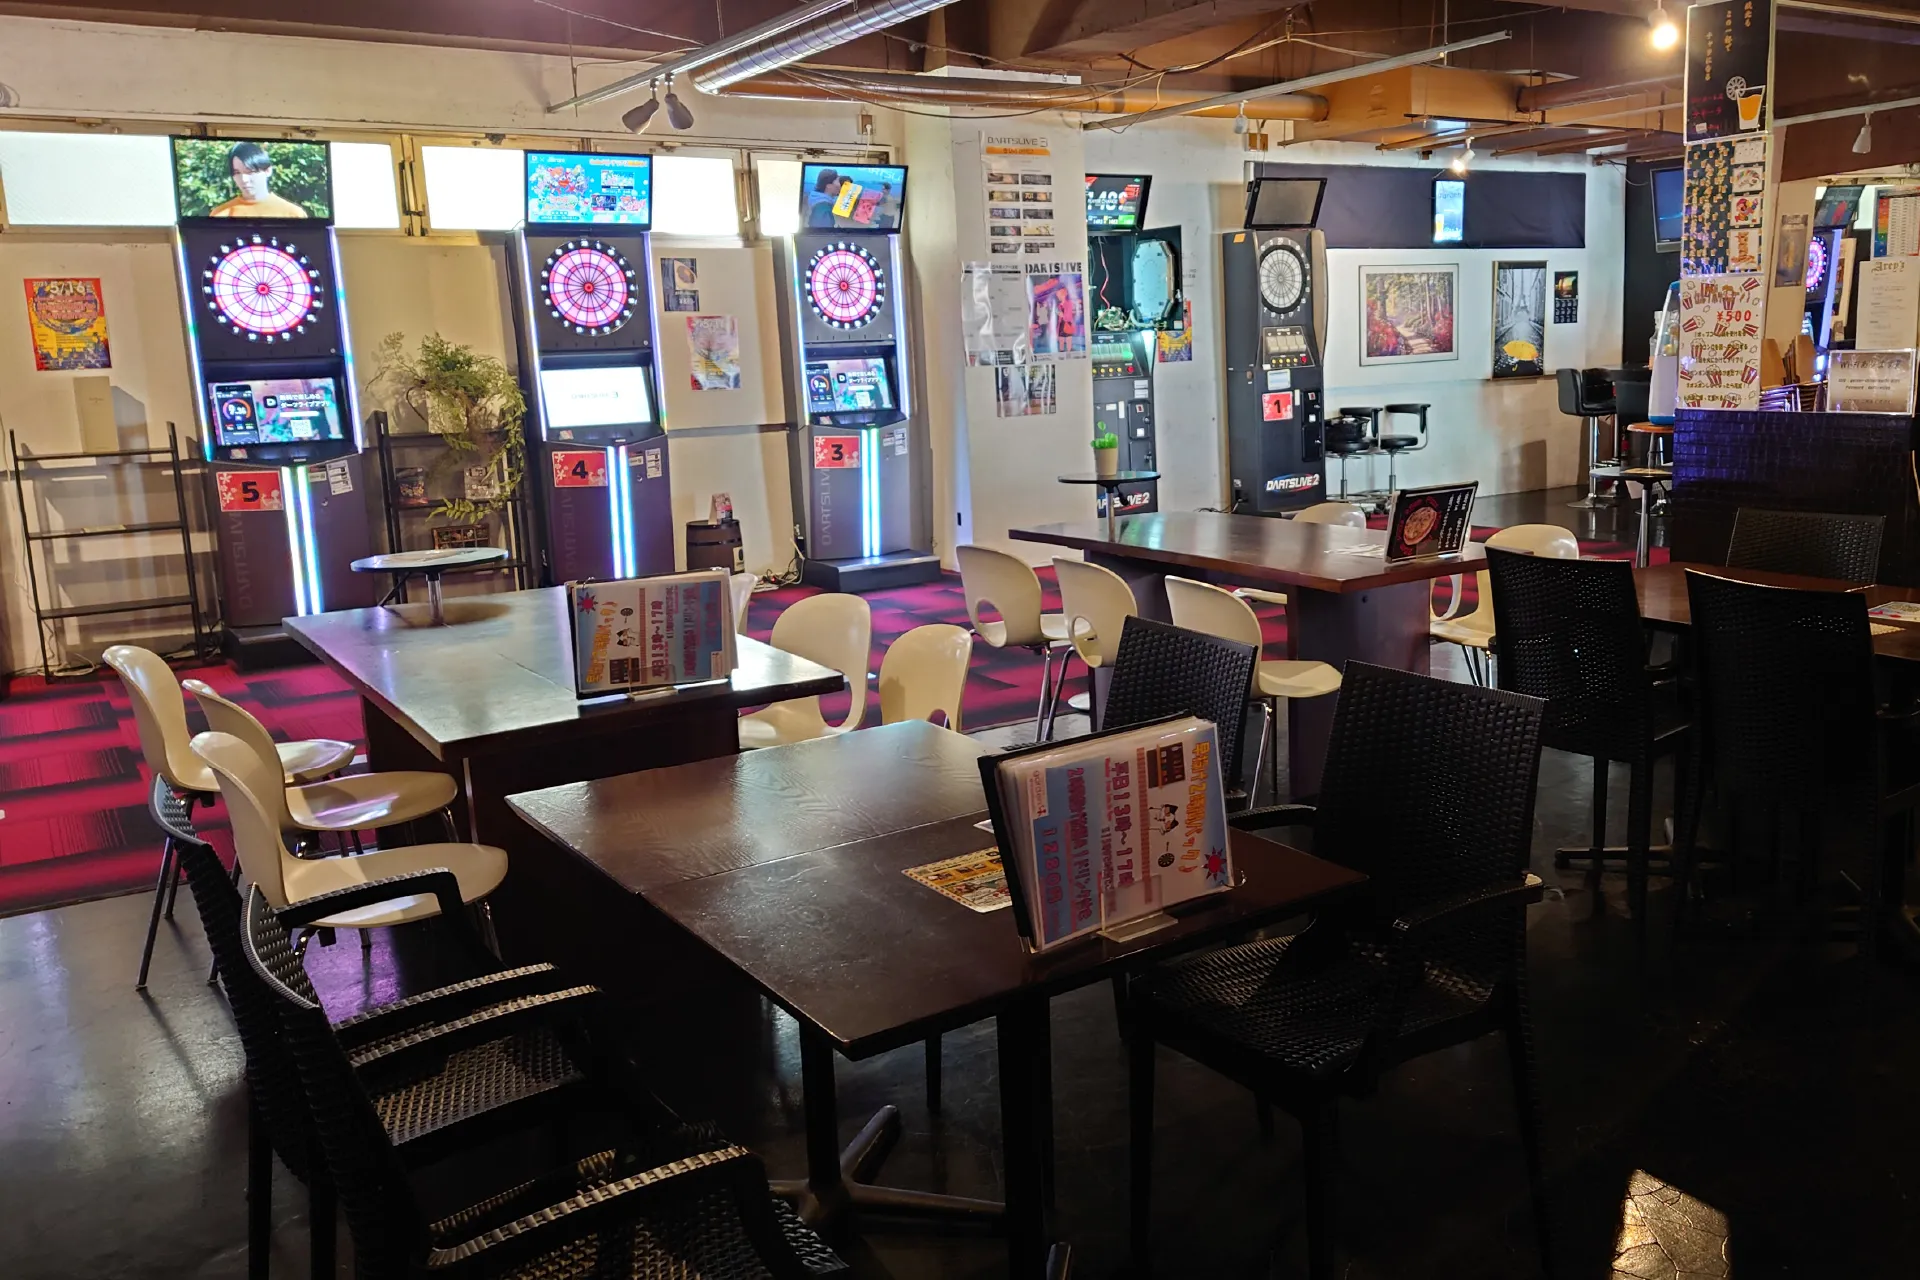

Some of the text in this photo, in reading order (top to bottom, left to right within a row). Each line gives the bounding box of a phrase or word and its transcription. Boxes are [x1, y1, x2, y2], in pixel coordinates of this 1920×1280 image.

[988, 137, 1038, 145] DARTSLIVE
[50, 280, 85, 294] 5/16
[1717, 309, 1752, 322] ¥500
[1273, 400, 1281, 413] 1
[831, 444, 843, 461] 3
[572, 460, 588, 478] 4
[242, 481, 259, 502] 5
